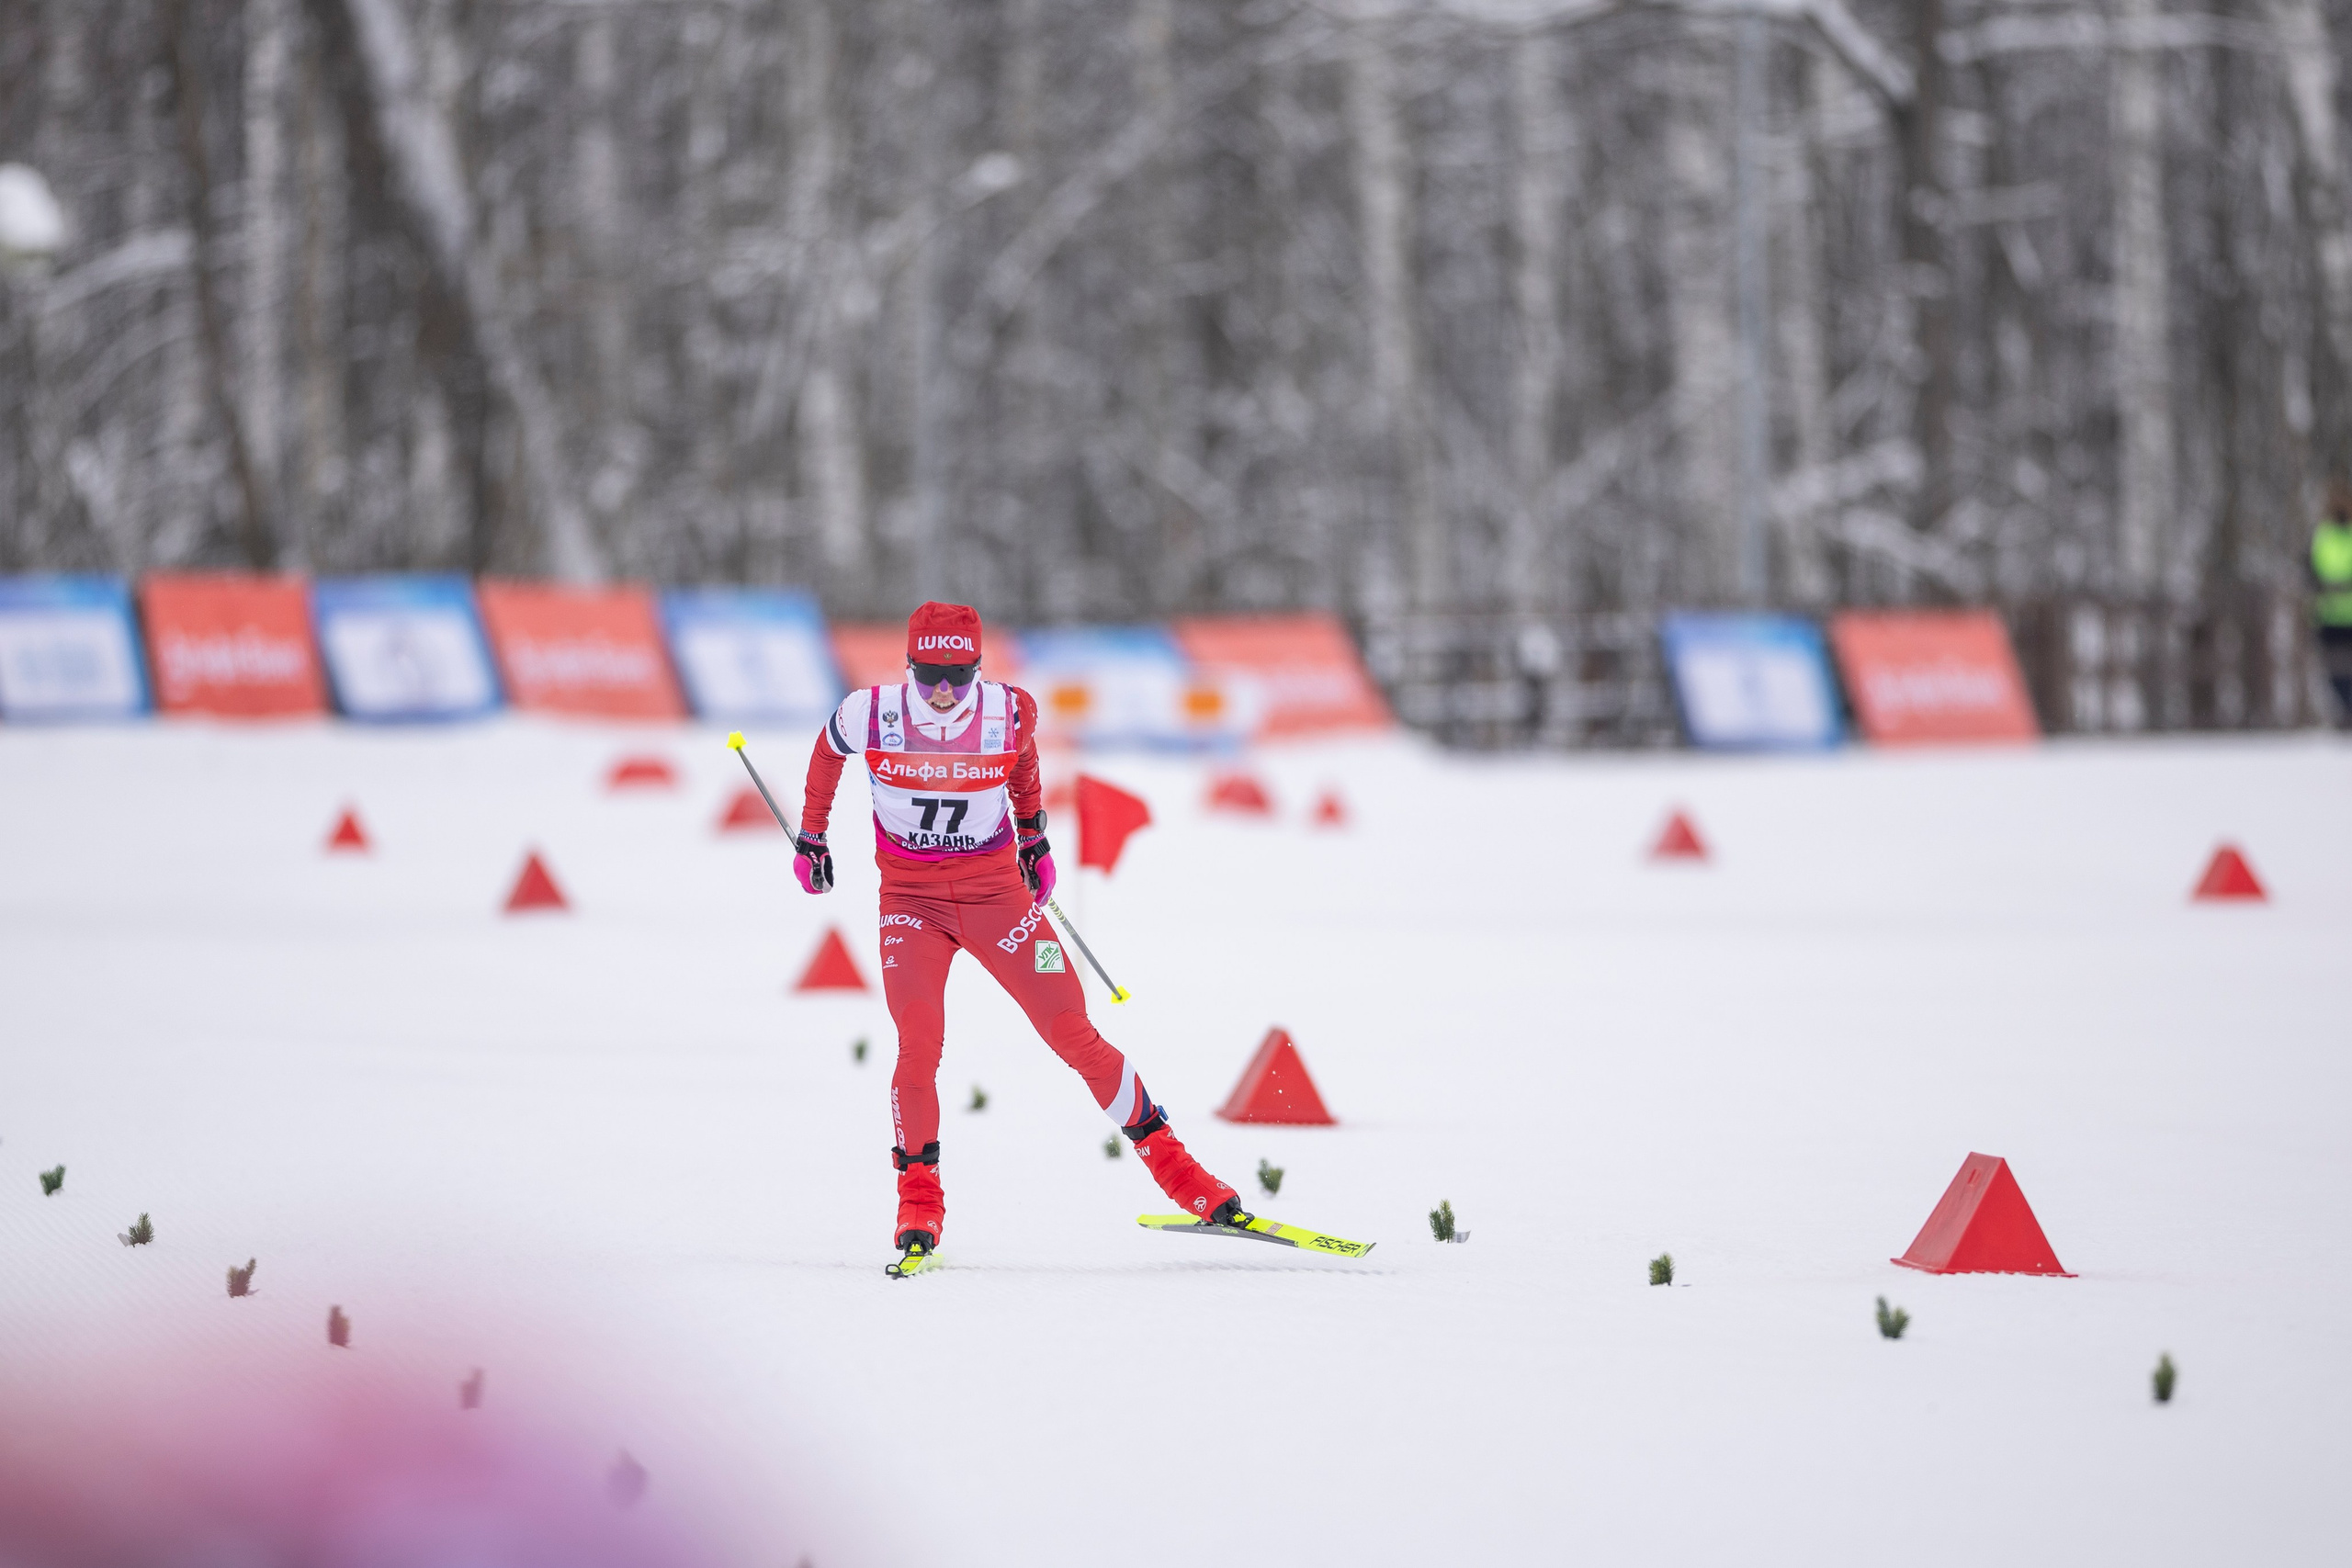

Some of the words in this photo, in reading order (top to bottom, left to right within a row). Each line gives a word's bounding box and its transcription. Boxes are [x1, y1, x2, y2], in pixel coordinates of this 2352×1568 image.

[917, 635, 975, 653] LUKOIL
[876, 758, 948, 782] Альфа
[952, 761, 1005, 780] Банк
[911, 797, 968, 834] 77
[909, 831, 976, 847] КАЗАНЬ
[879, 914, 923, 931] UKOIL
[996, 901, 1044, 954] BOSCO
[1309, 1235, 1362, 1255] FISCHER
